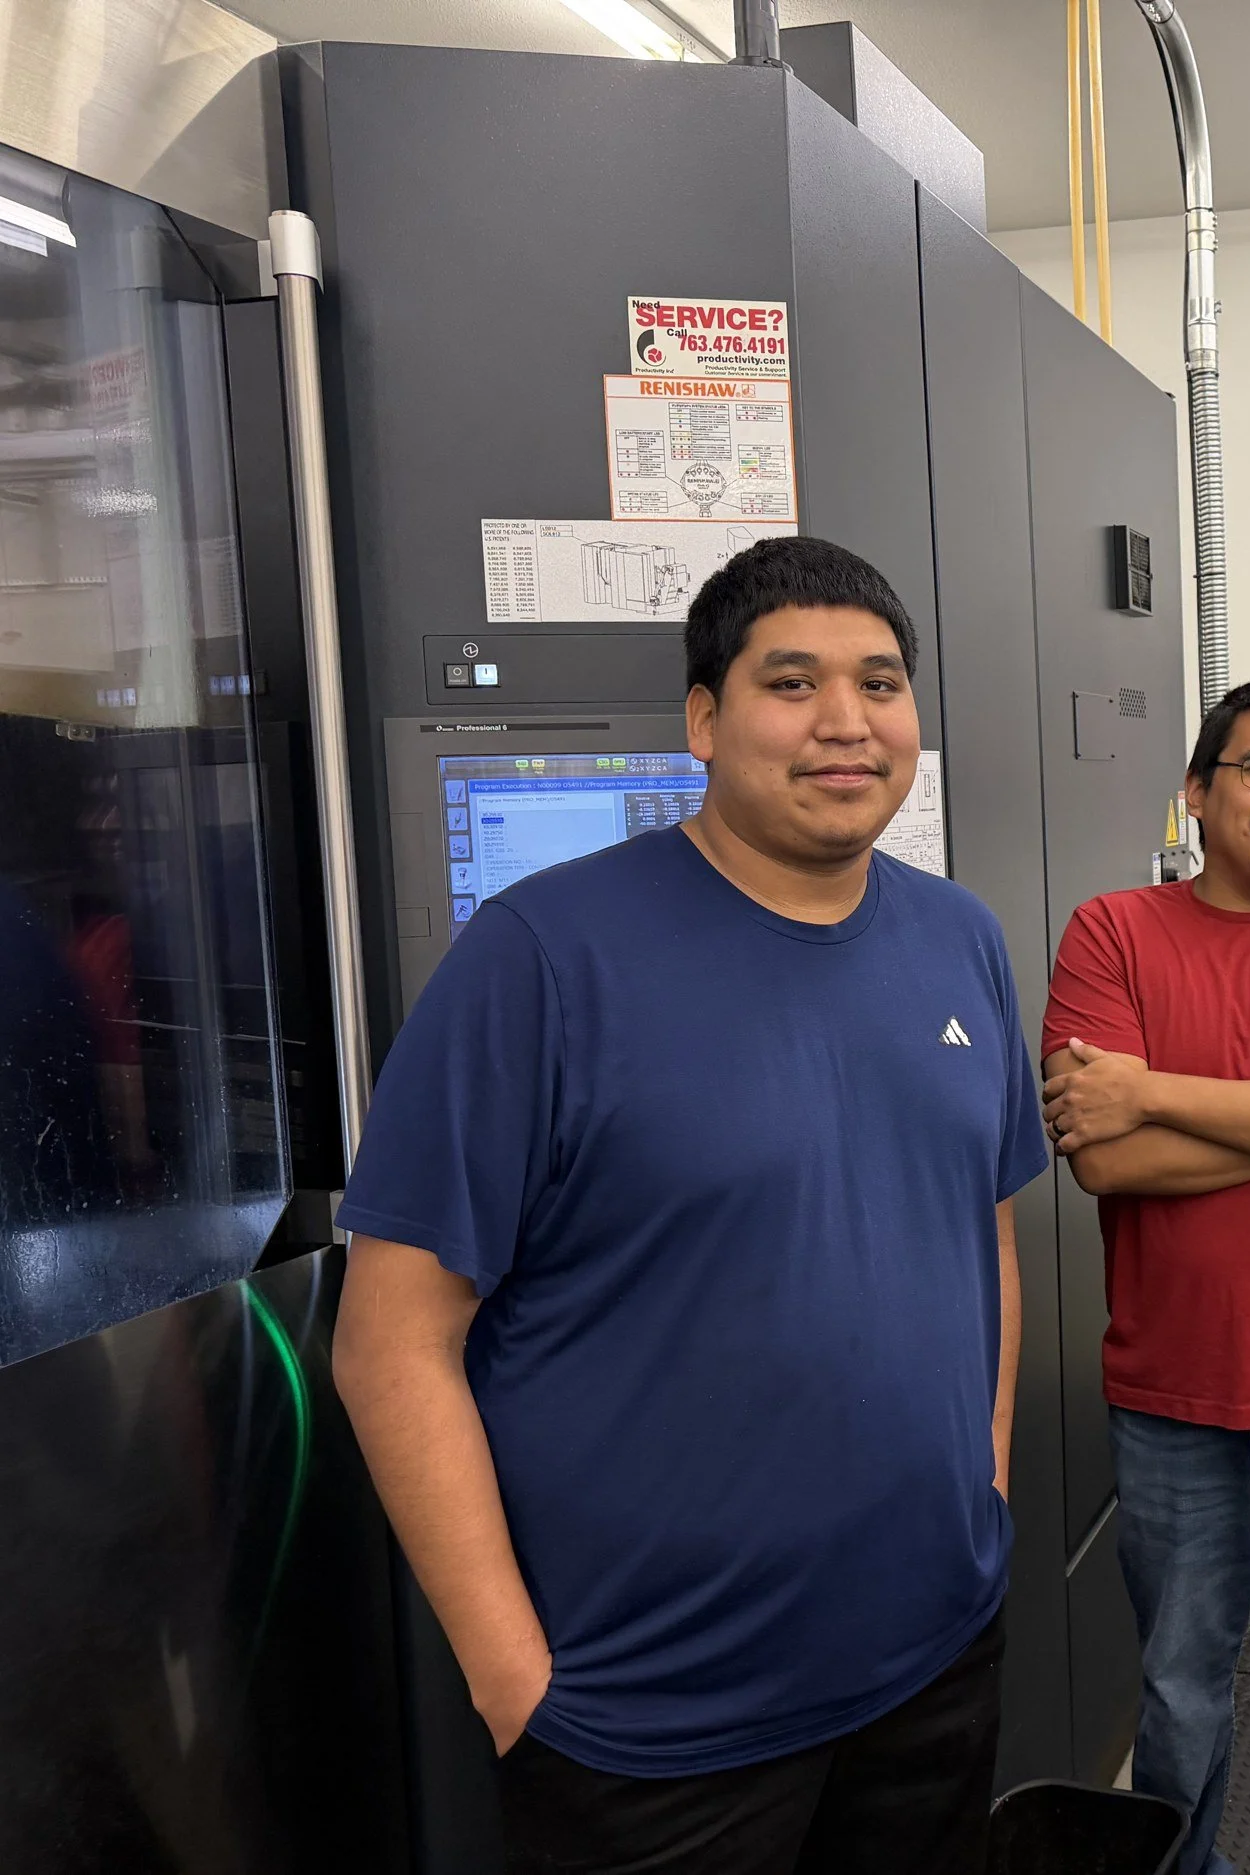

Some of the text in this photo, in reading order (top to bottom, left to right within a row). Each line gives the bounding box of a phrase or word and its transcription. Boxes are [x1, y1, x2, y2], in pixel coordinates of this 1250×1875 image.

[632, 300, 661, 309] Need
[635, 305, 784, 331] SERVICE?
[666, 328, 688, 337] Call
[679, 335, 785, 354] 763.476.4191
[697, 355, 786, 365] productivity.com
[639, 381, 736, 397] RENISHAW
